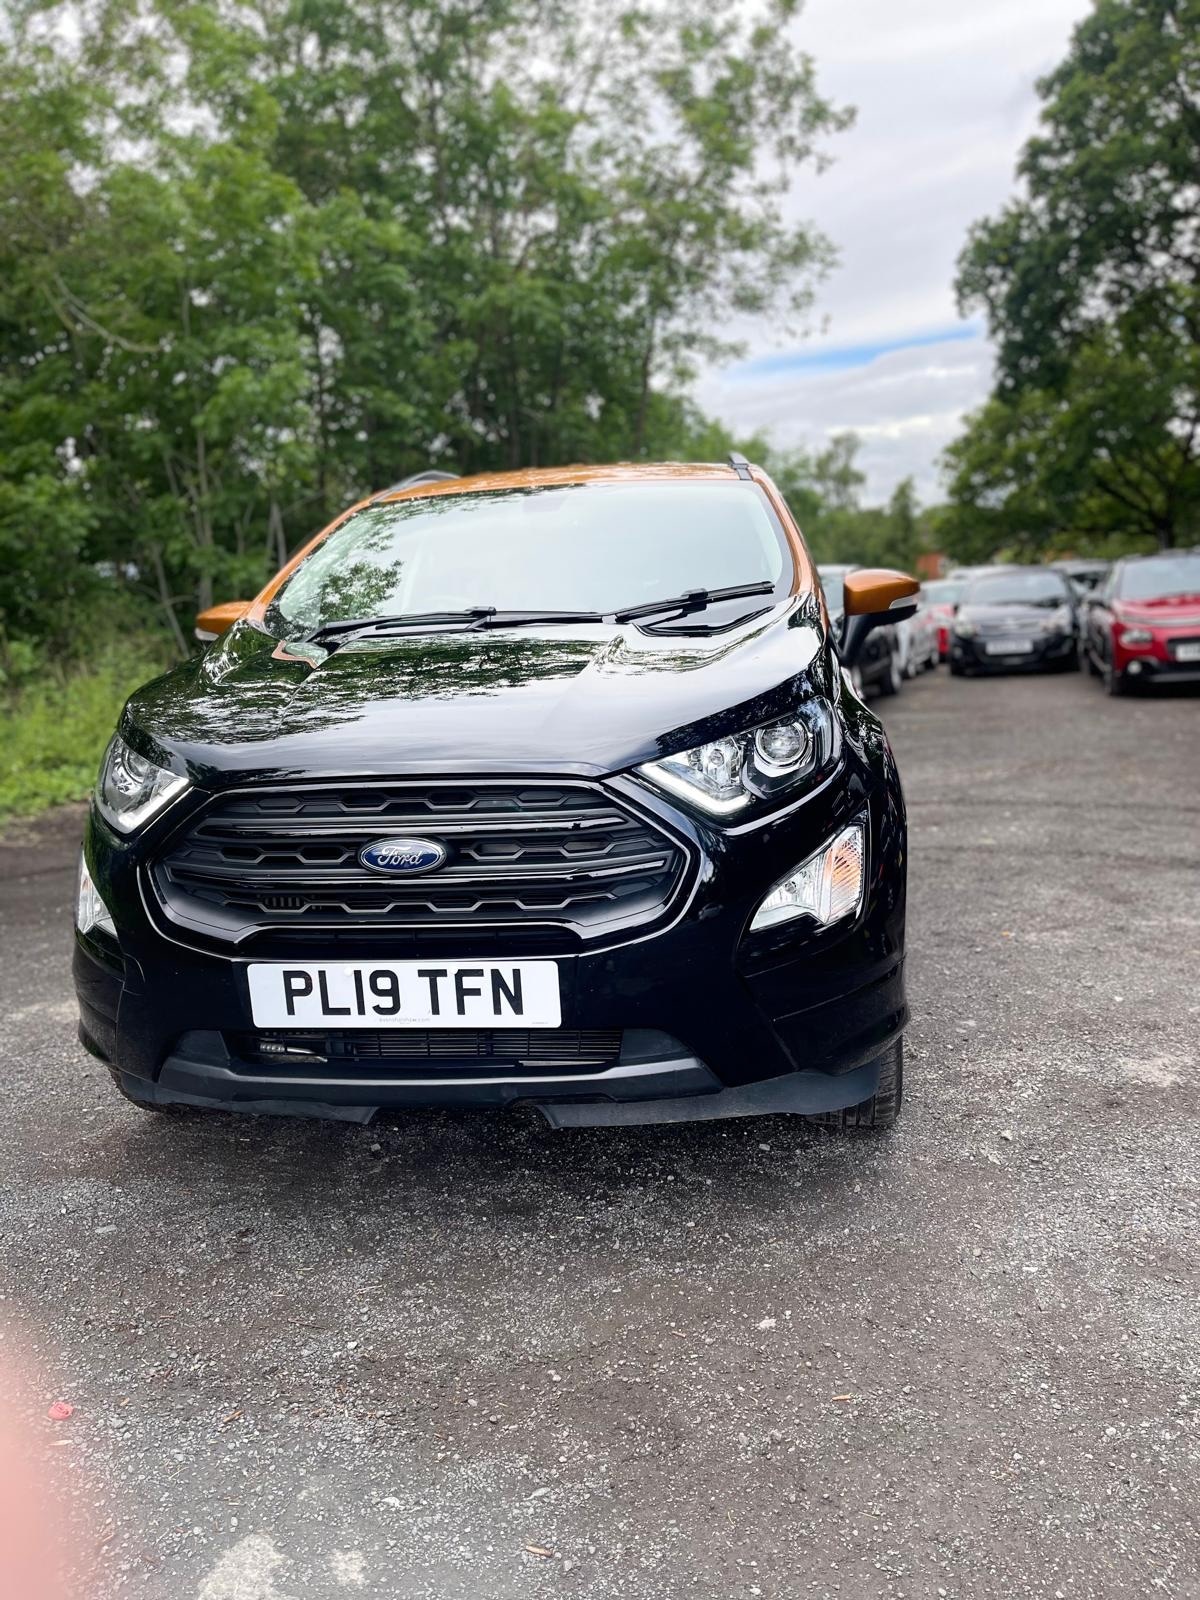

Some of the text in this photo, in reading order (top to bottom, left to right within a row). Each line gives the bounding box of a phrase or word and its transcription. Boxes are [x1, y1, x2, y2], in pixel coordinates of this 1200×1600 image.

[377, 845, 423, 866] Ford
[282, 968, 524, 1015] PL19 TFN
